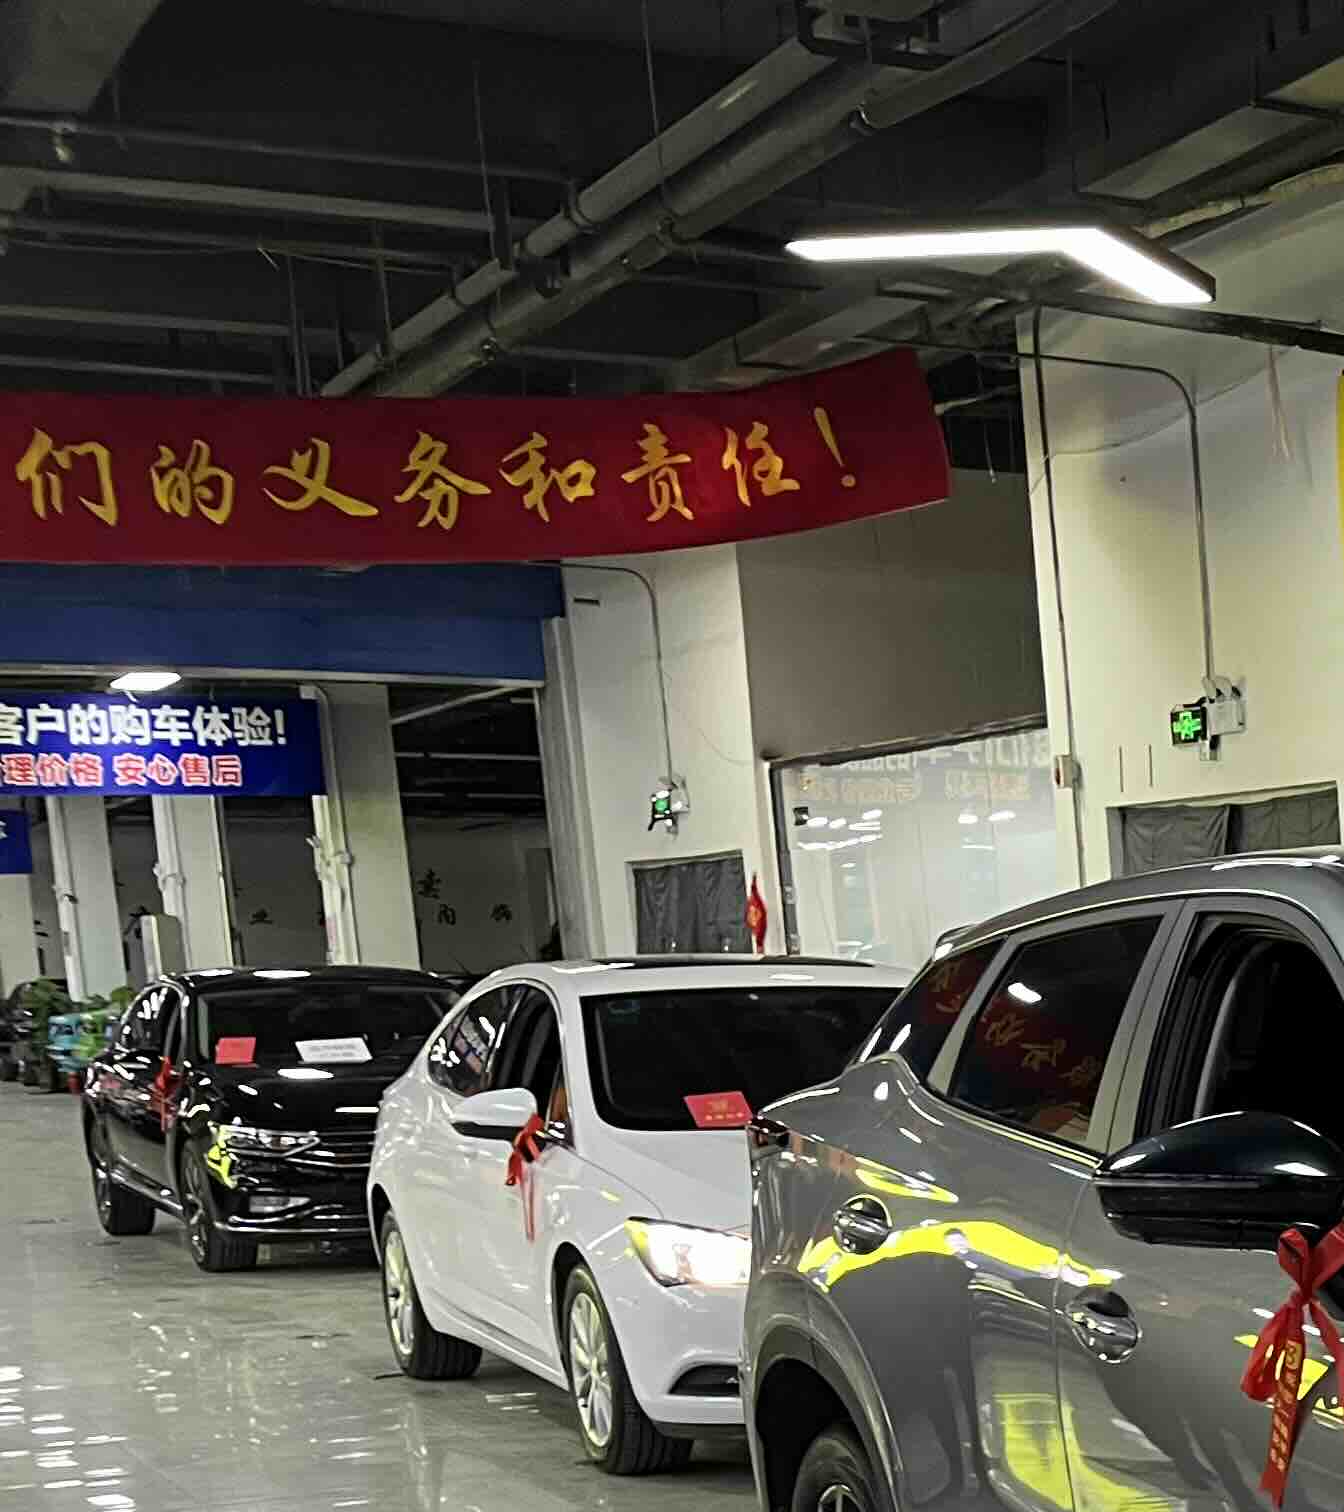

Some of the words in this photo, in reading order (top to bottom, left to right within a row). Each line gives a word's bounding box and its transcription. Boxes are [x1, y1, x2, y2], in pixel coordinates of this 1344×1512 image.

[0, 752, 104, 787] 理价格
[112, 753, 243, 788] 安心售后
